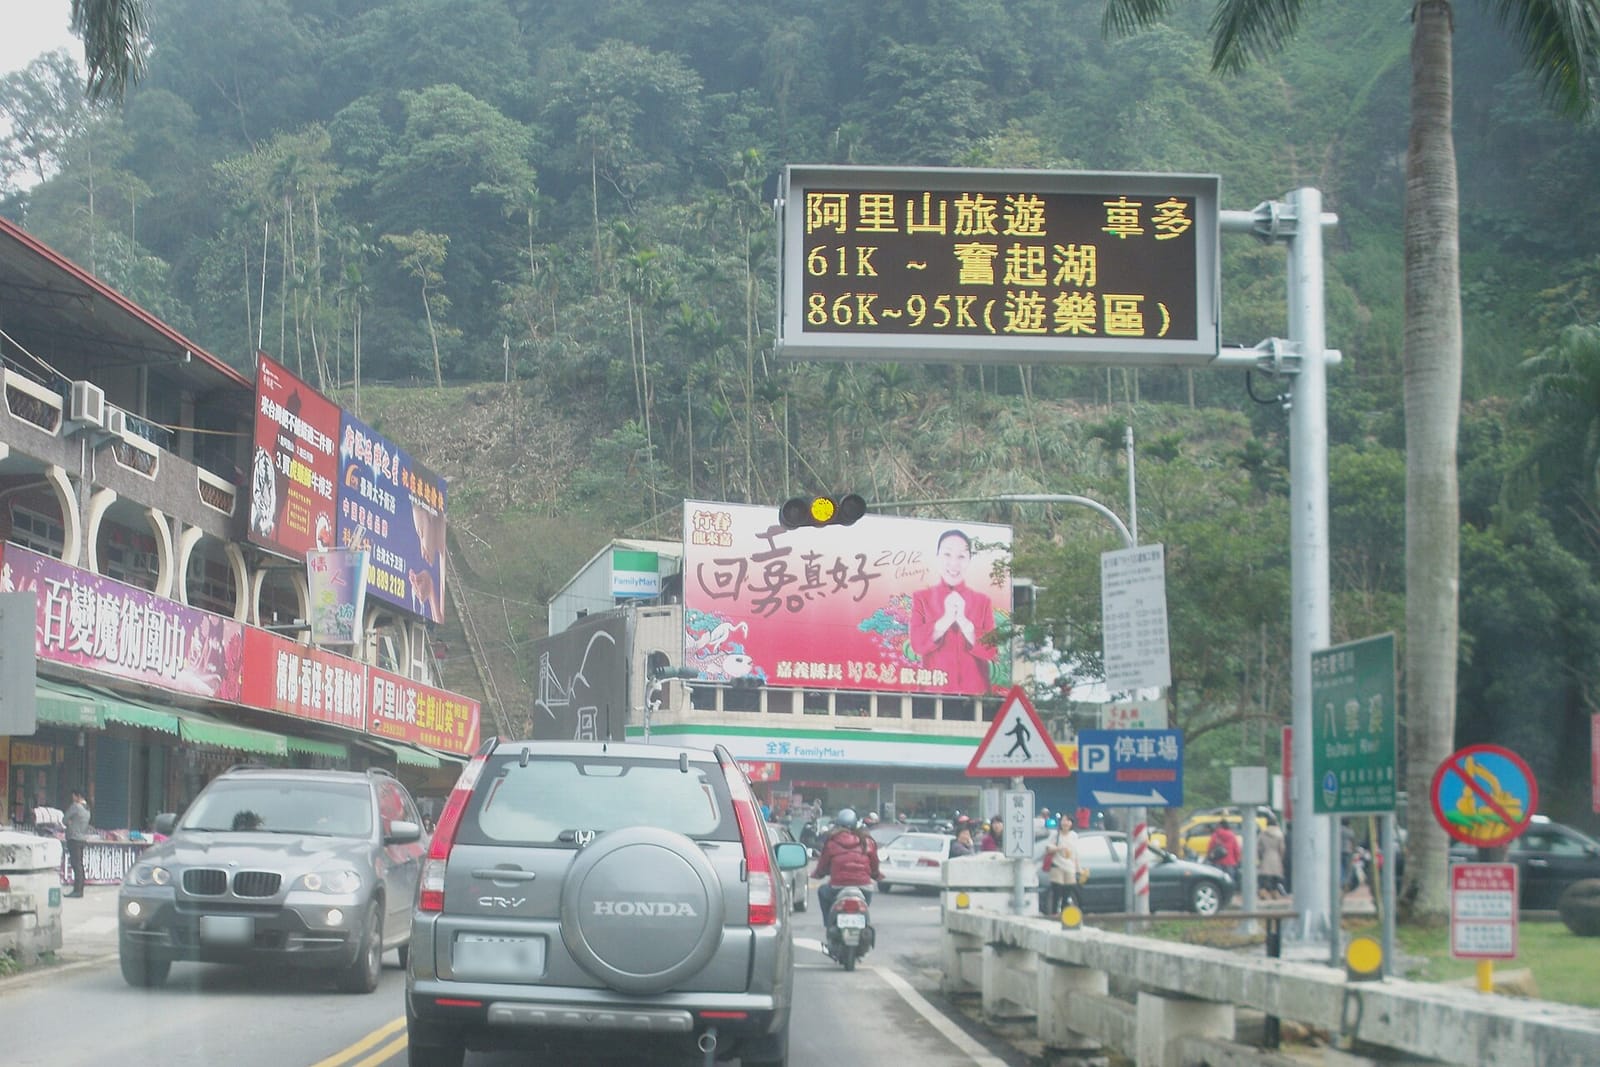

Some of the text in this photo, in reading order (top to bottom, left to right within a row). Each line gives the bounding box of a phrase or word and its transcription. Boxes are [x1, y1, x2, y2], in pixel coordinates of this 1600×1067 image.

[806, 192, 1193, 240] 阿里山旅遊 車多
[808, 246, 879, 277] 61K
[953, 242, 1097, 287] 奮起湖
[692, 510, 732, 531] 行春
[873, 549, 922, 568] 2012
[613, 575, 657, 587] FamilyMart
[44, 576, 187, 679] 百變魔術圍巾
[776, 660, 843, 681] 嘉義縣長
[900, 668, 949, 687] 歡迎你
[372, 675, 417, 724] 阿里山茶
[765, 741, 845, 758] 全家 FamilyMart
[1114, 735, 1179, 763] 停車場
[1012, 795, 1025, 854] 當心行人
[592, 901, 697, 917] HONDA
